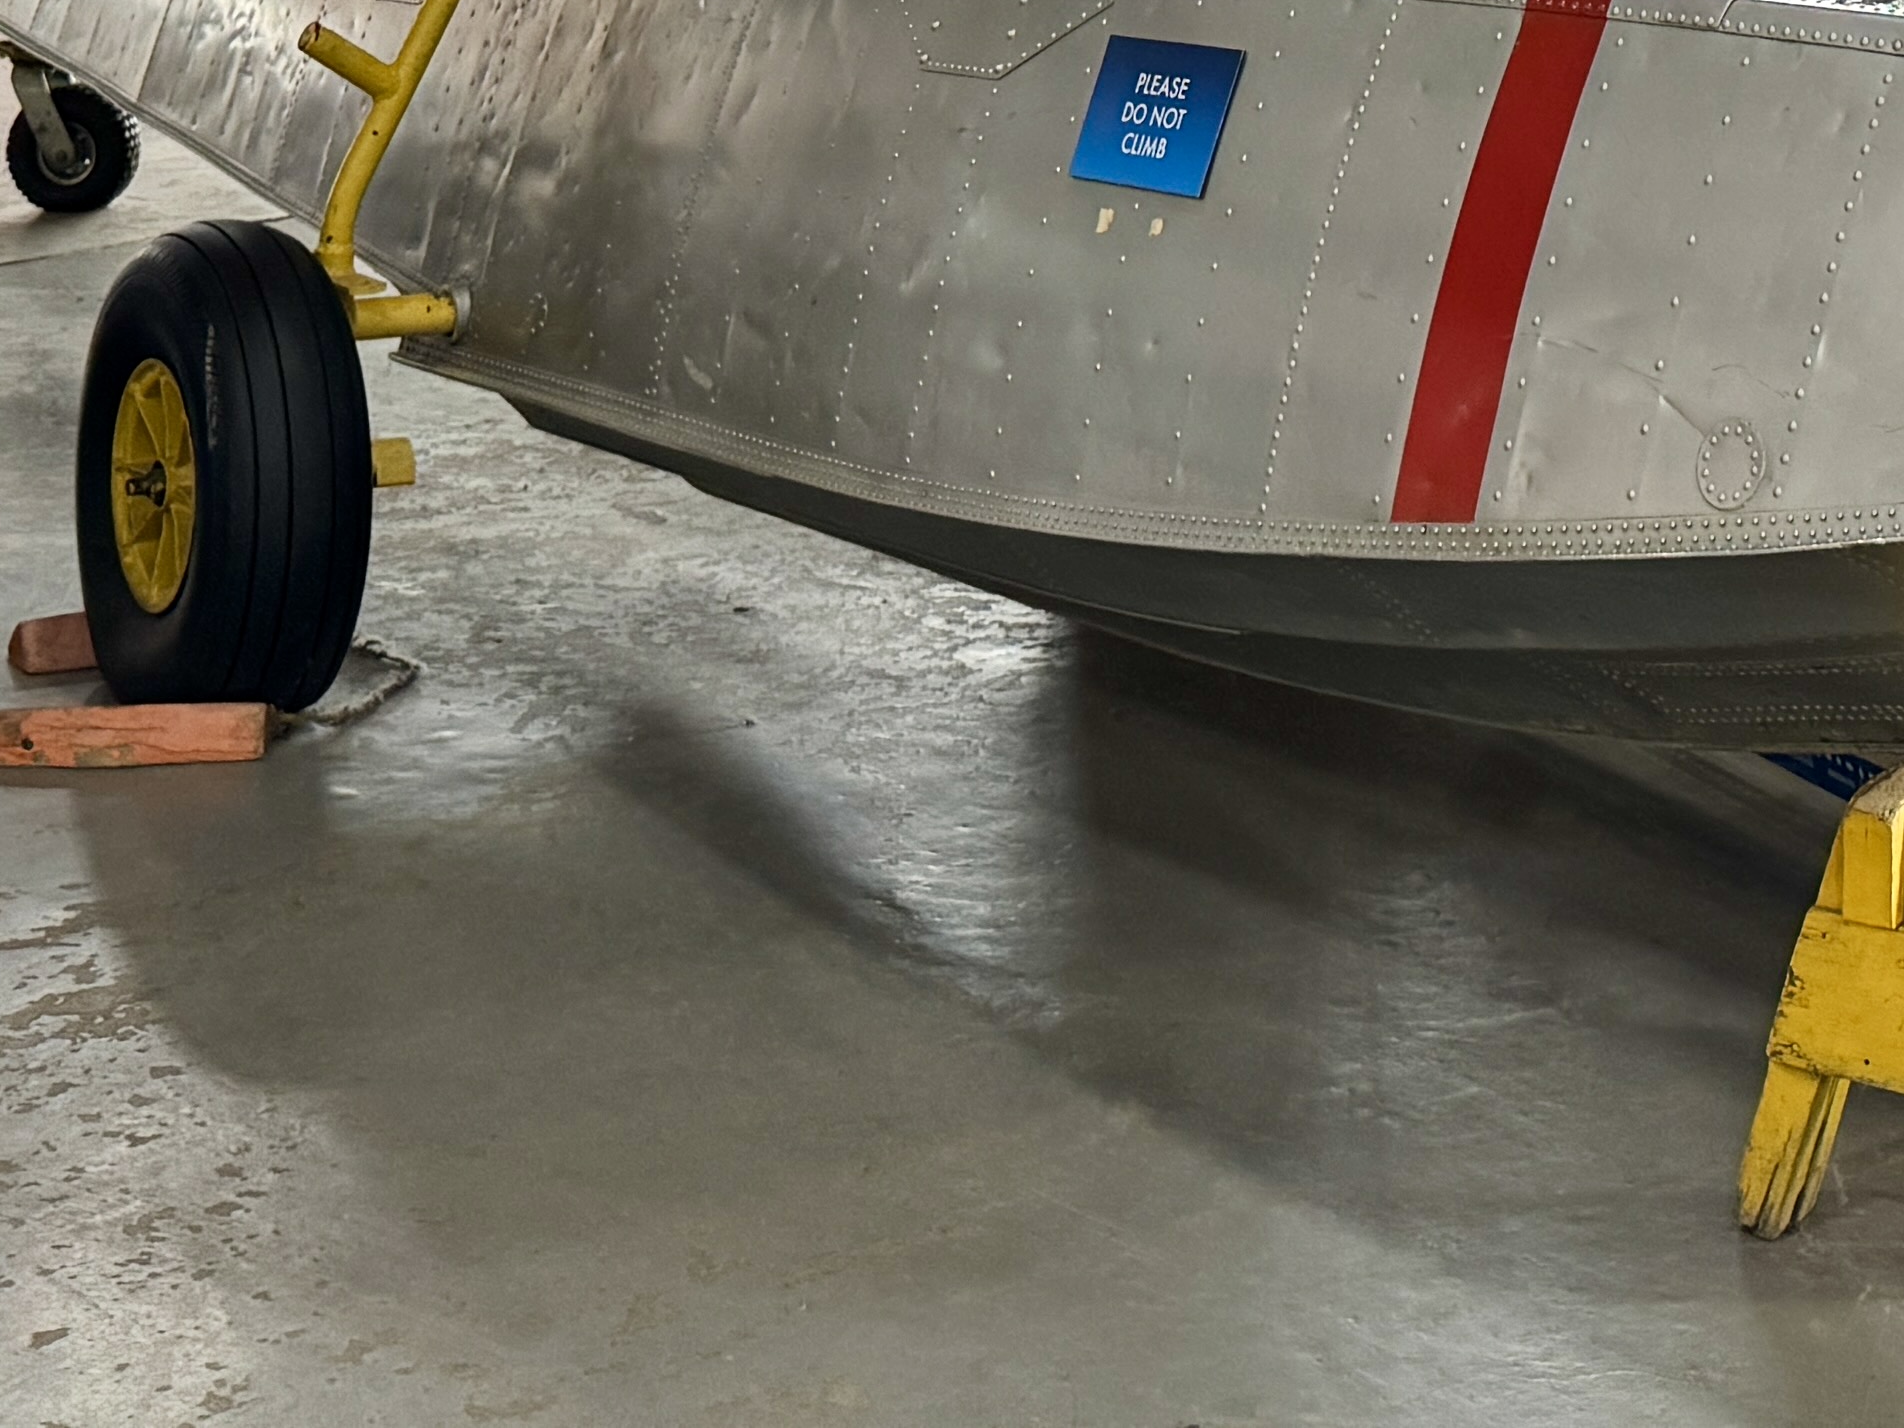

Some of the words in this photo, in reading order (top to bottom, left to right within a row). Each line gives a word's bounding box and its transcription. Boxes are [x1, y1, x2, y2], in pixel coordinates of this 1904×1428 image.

[1135, 72, 1191, 100] PLEASE
[1121, 101, 1148, 125] DO
[1149, 105, 1188, 130] NOT
[1121, 132, 1167, 159] CLIMB
